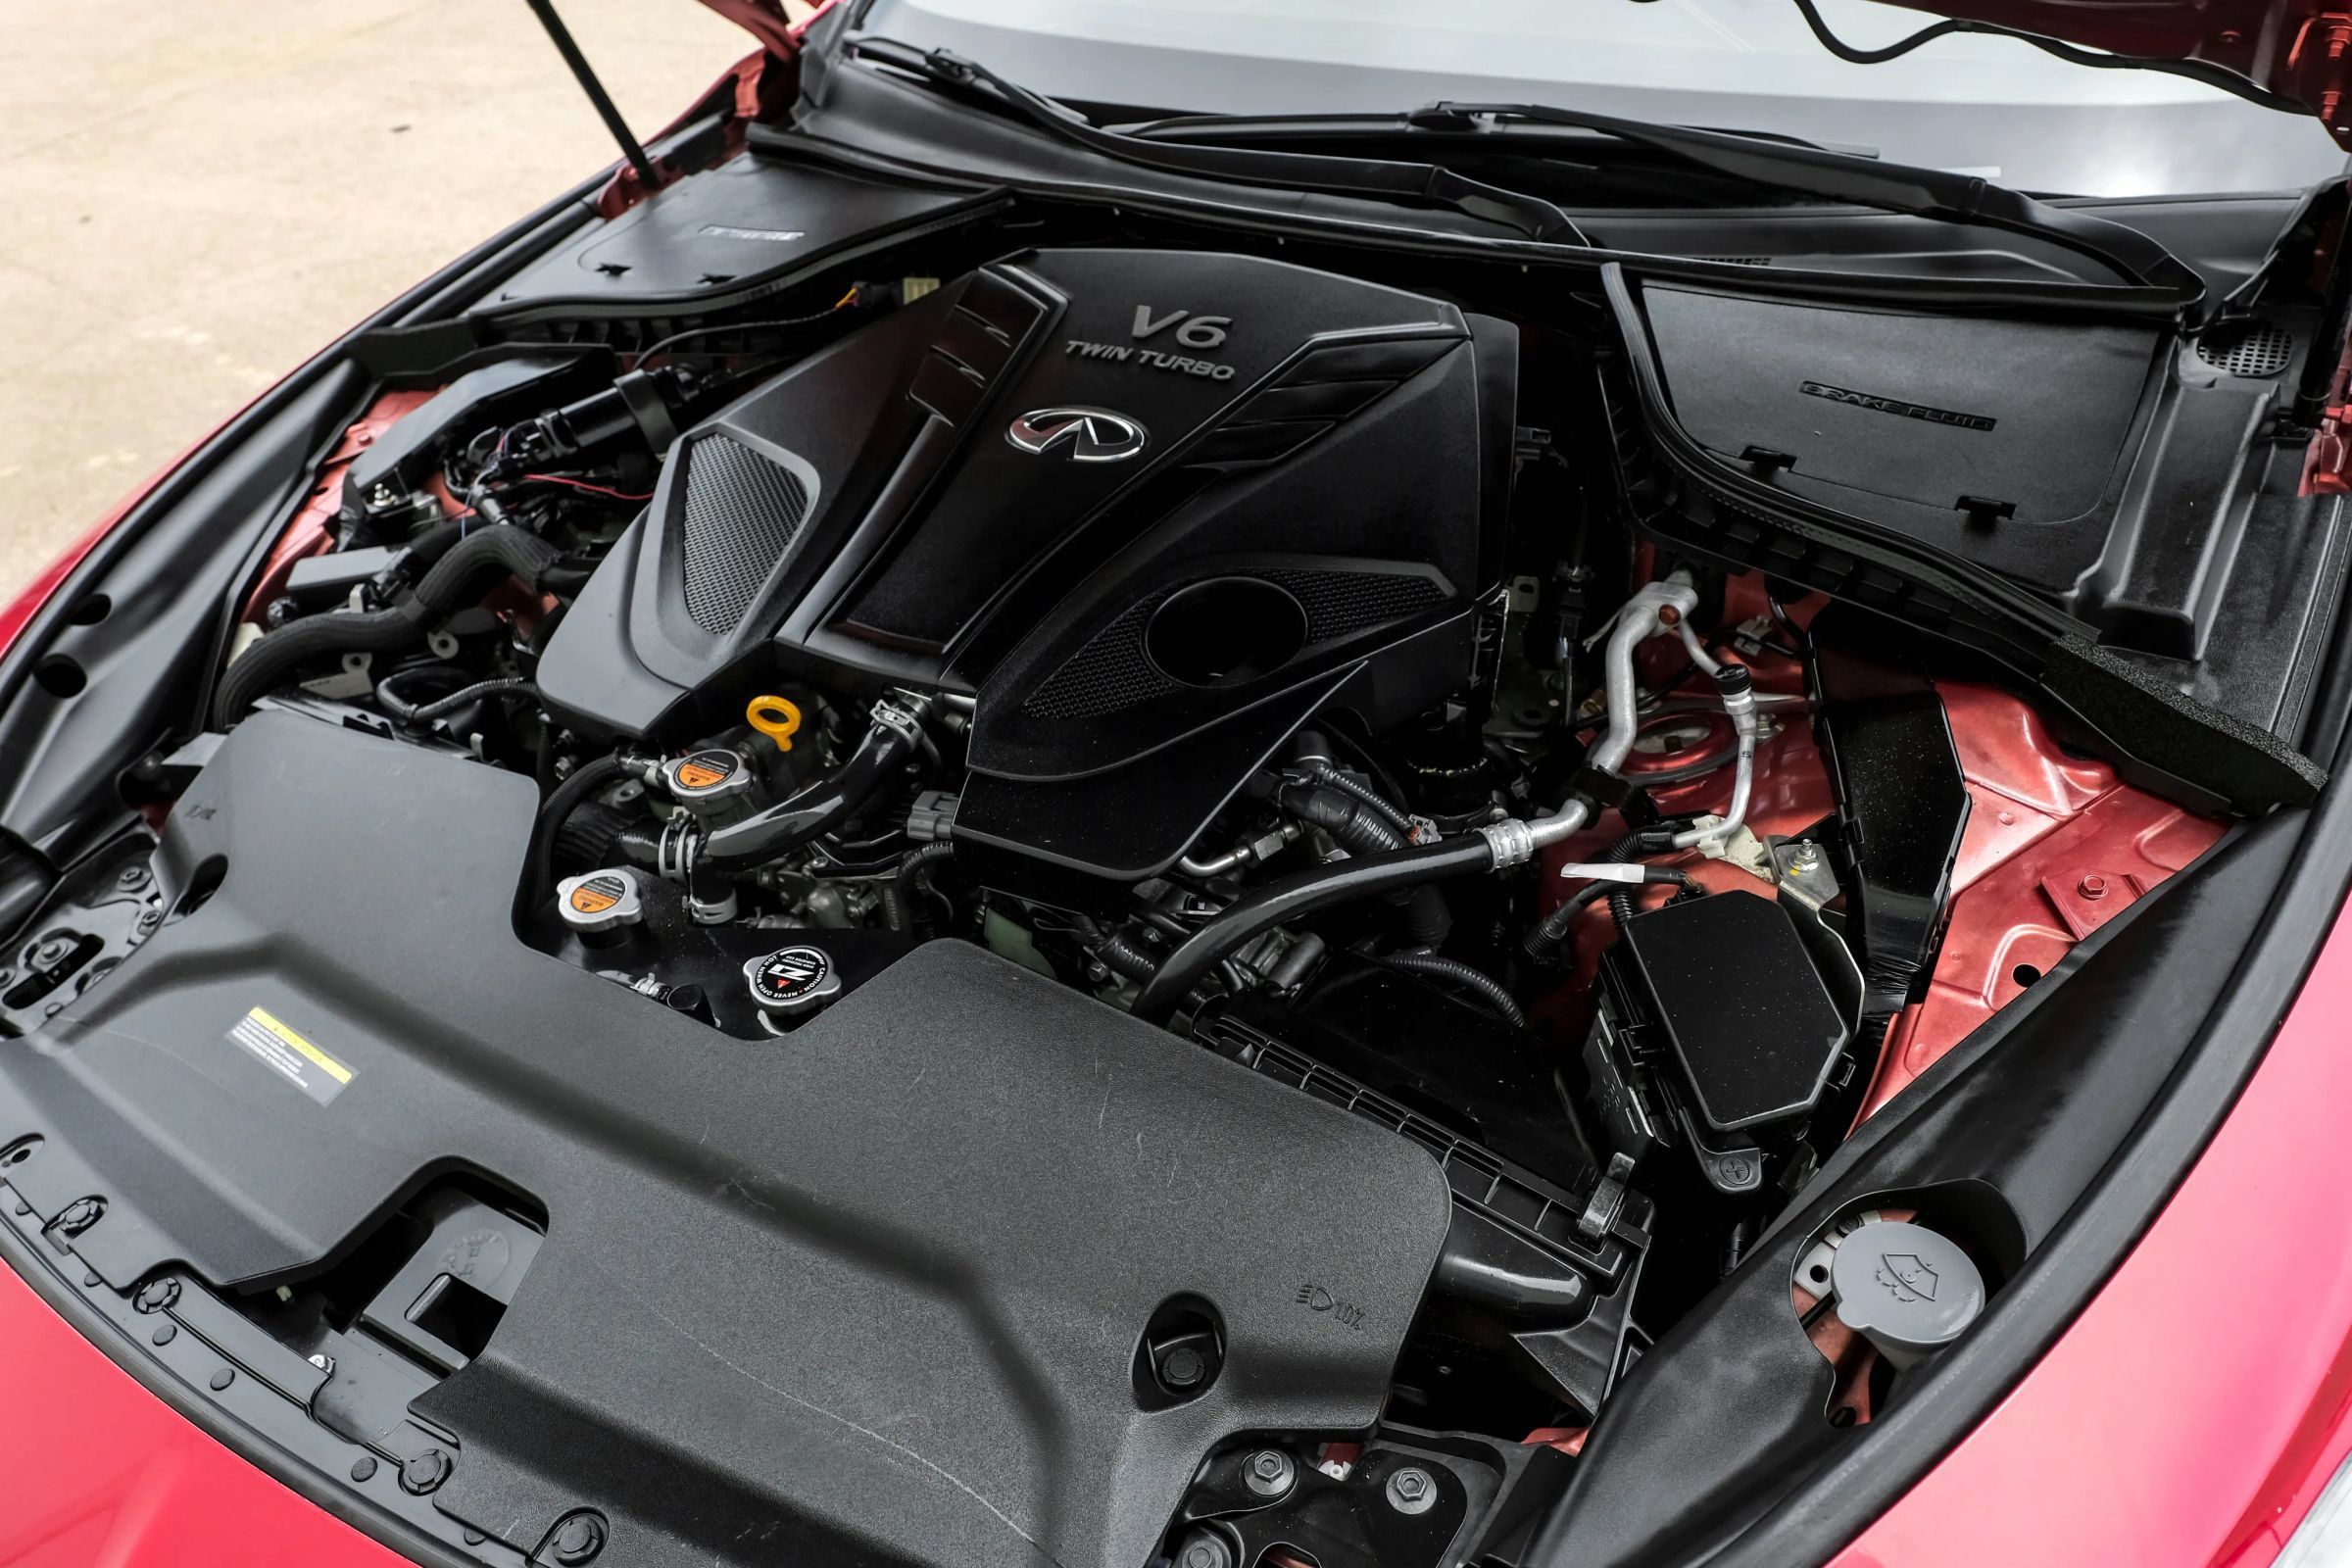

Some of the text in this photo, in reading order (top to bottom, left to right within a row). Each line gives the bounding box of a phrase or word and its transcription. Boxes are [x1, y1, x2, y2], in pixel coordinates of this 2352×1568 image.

[1132, 305, 1233, 349] V6
[1065, 340, 1236, 381] TWIN TURBO
[1802, 382, 1995, 431] BRAKE FLUID
[764, 955, 778, 966] HOT
[758, 983, 773, 996] OPEN
[804, 967, 826, 992] CAUTION
